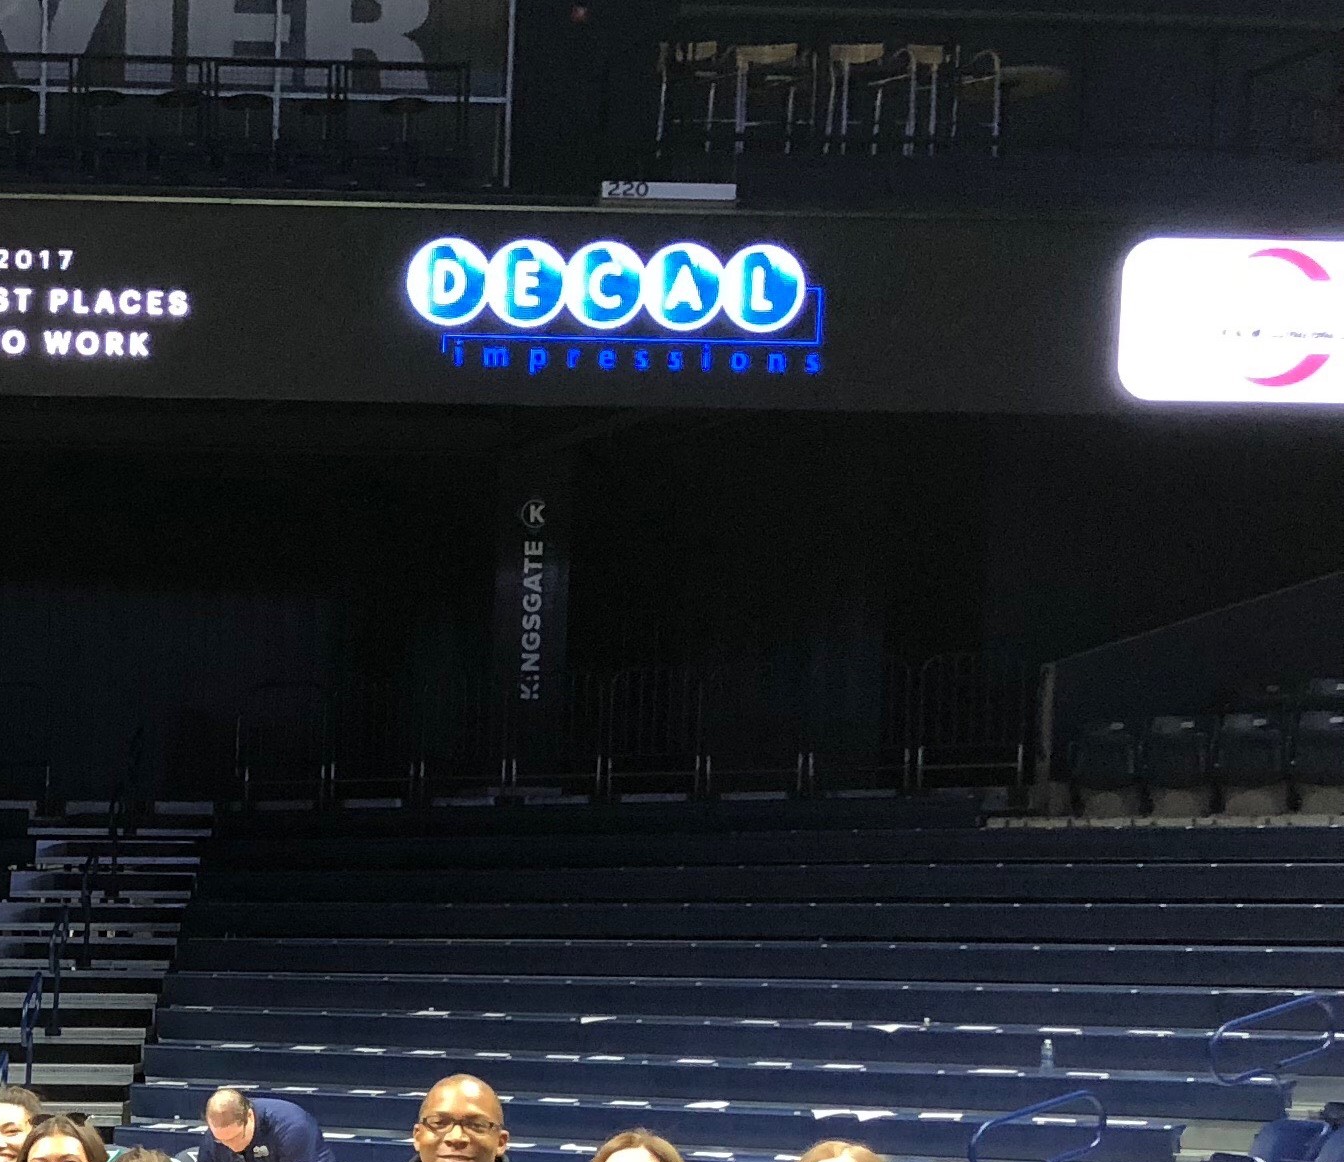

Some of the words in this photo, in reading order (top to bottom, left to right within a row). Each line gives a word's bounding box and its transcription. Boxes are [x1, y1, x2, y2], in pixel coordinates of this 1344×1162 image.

[607, 181, 649, 197] 220
[422, 250, 782, 322] DECAL
[48, 287, 190, 317] PLACES
[43, 330, 150, 358] WORK
[452, 340, 821, 375] impressions
